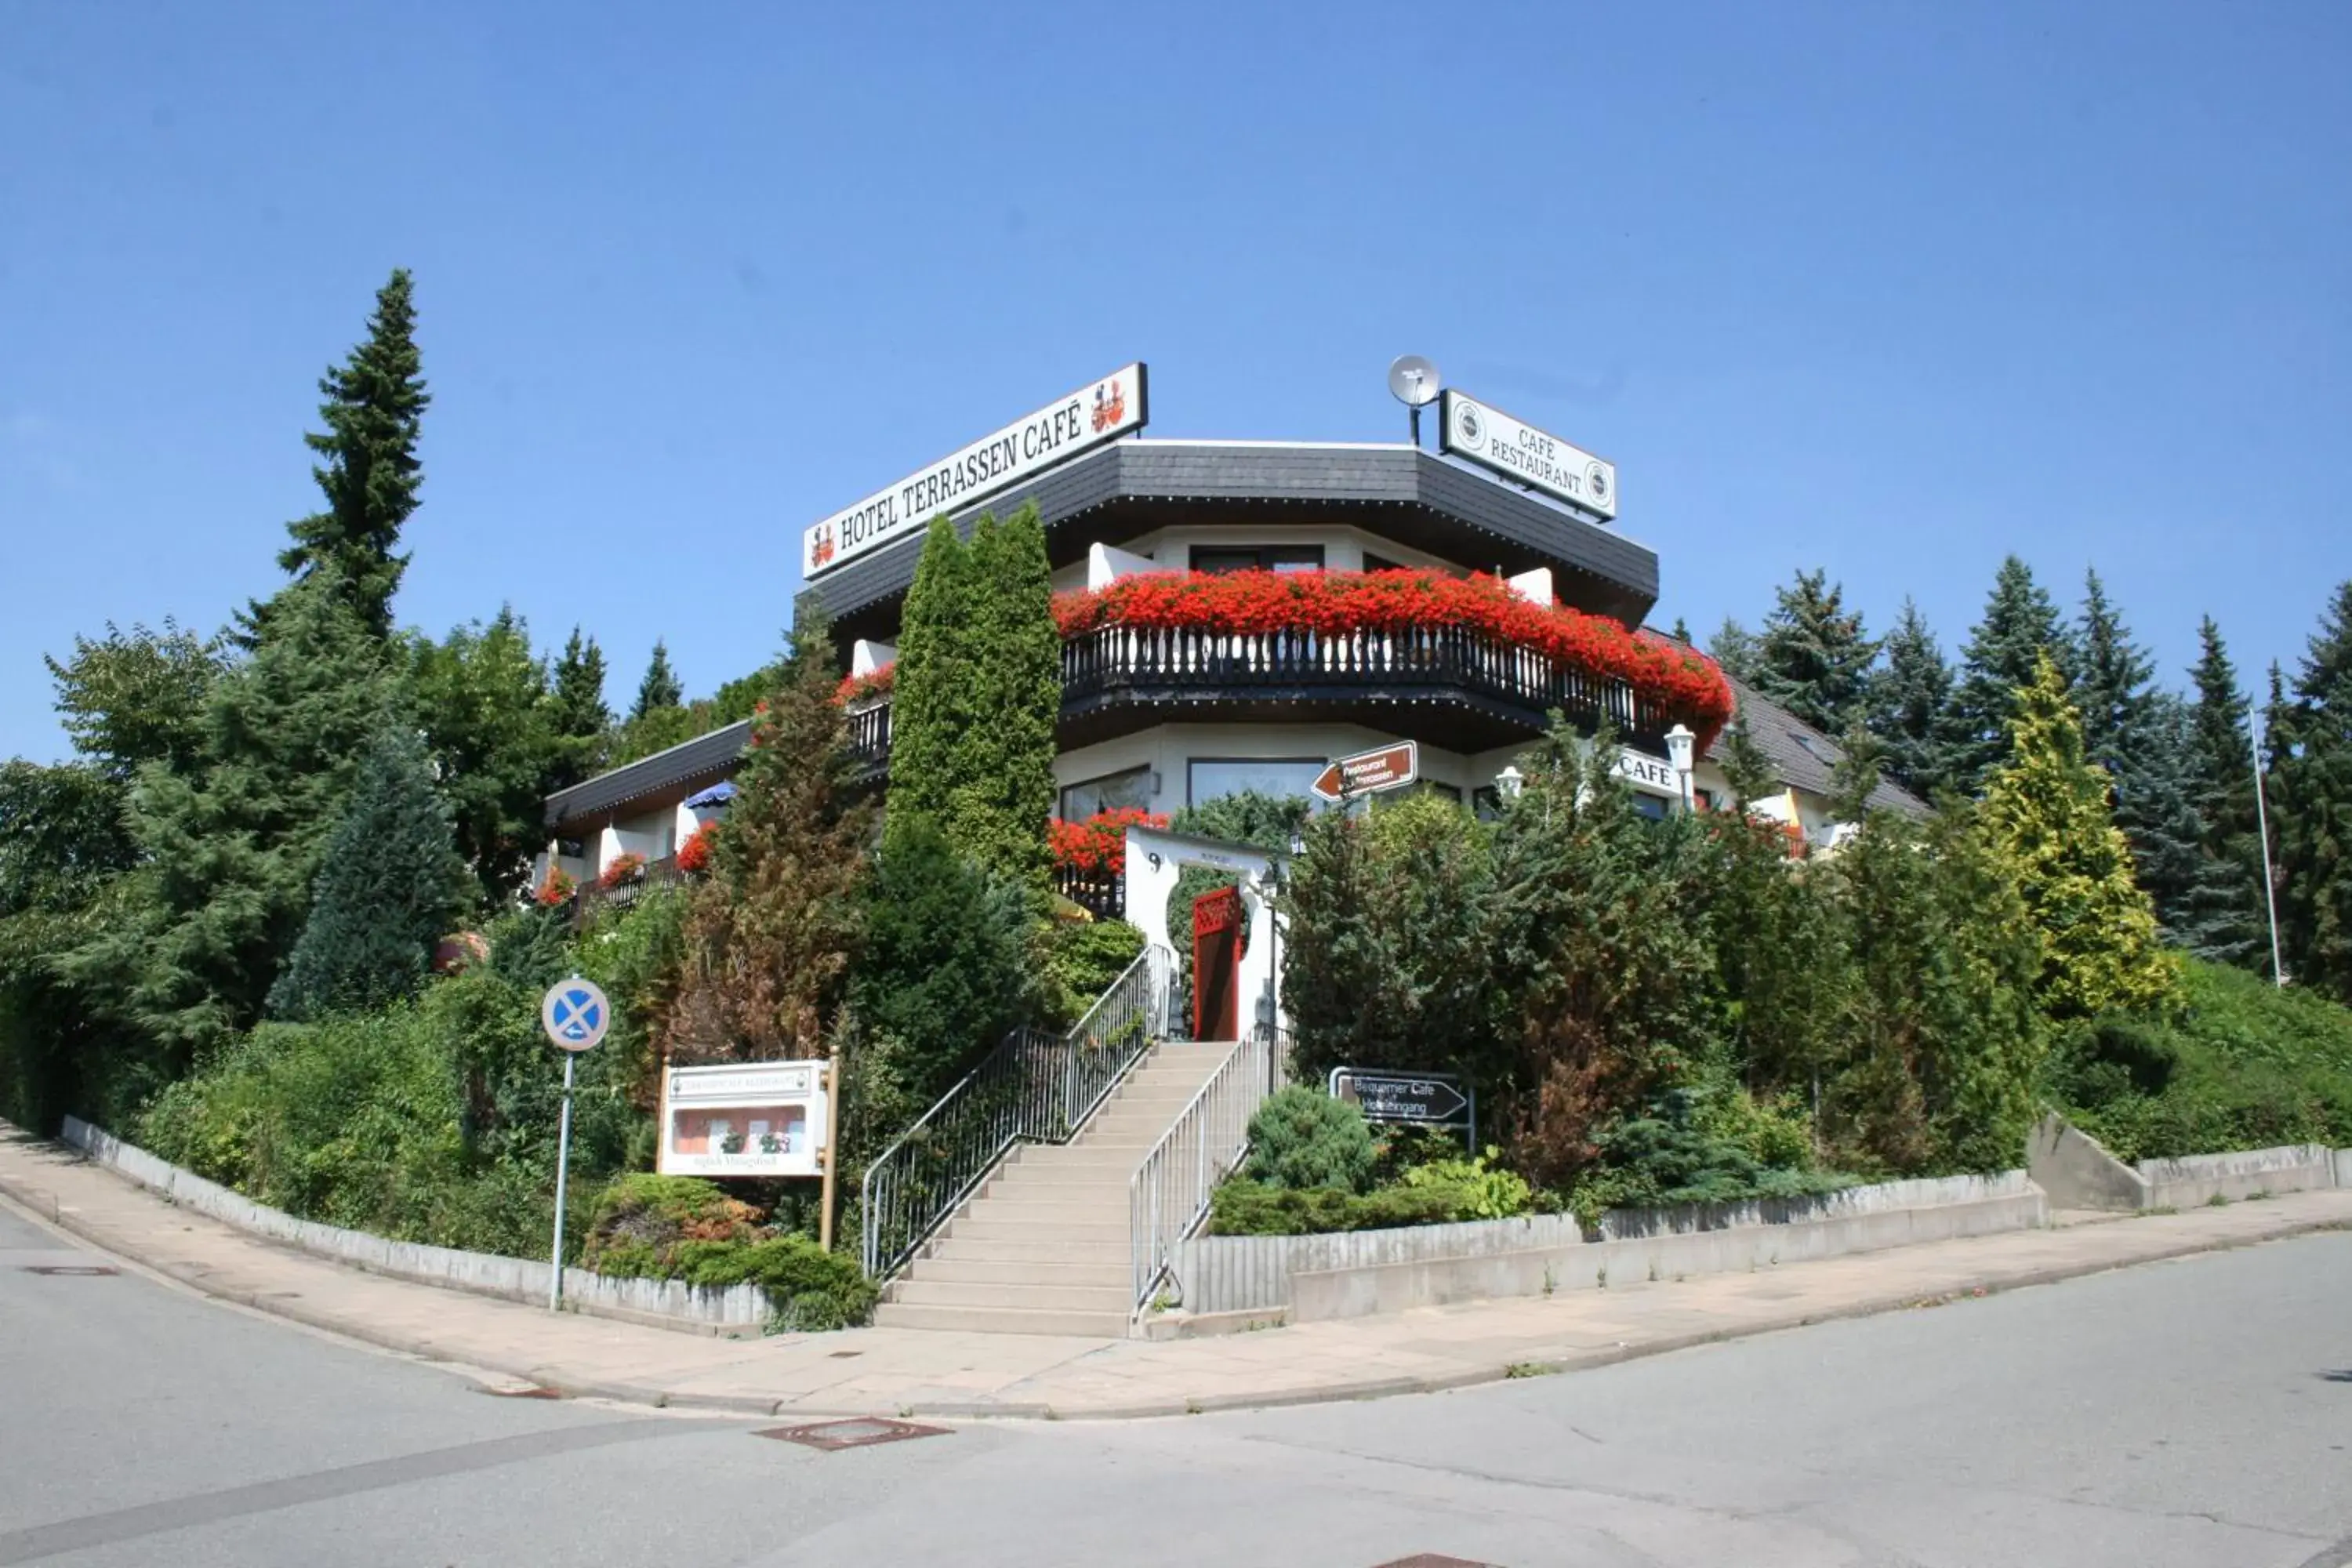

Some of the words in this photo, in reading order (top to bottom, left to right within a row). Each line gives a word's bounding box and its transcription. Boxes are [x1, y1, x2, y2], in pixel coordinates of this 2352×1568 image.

[841, 495, 898, 550] HOTEL
[902, 433, 1018, 518] TERRASSEN
[1023, 399, 1081, 459] CAFÉ
[1491, 437, 1582, 494] RESTAURANT
[1149, 852, 1160, 873] 9
